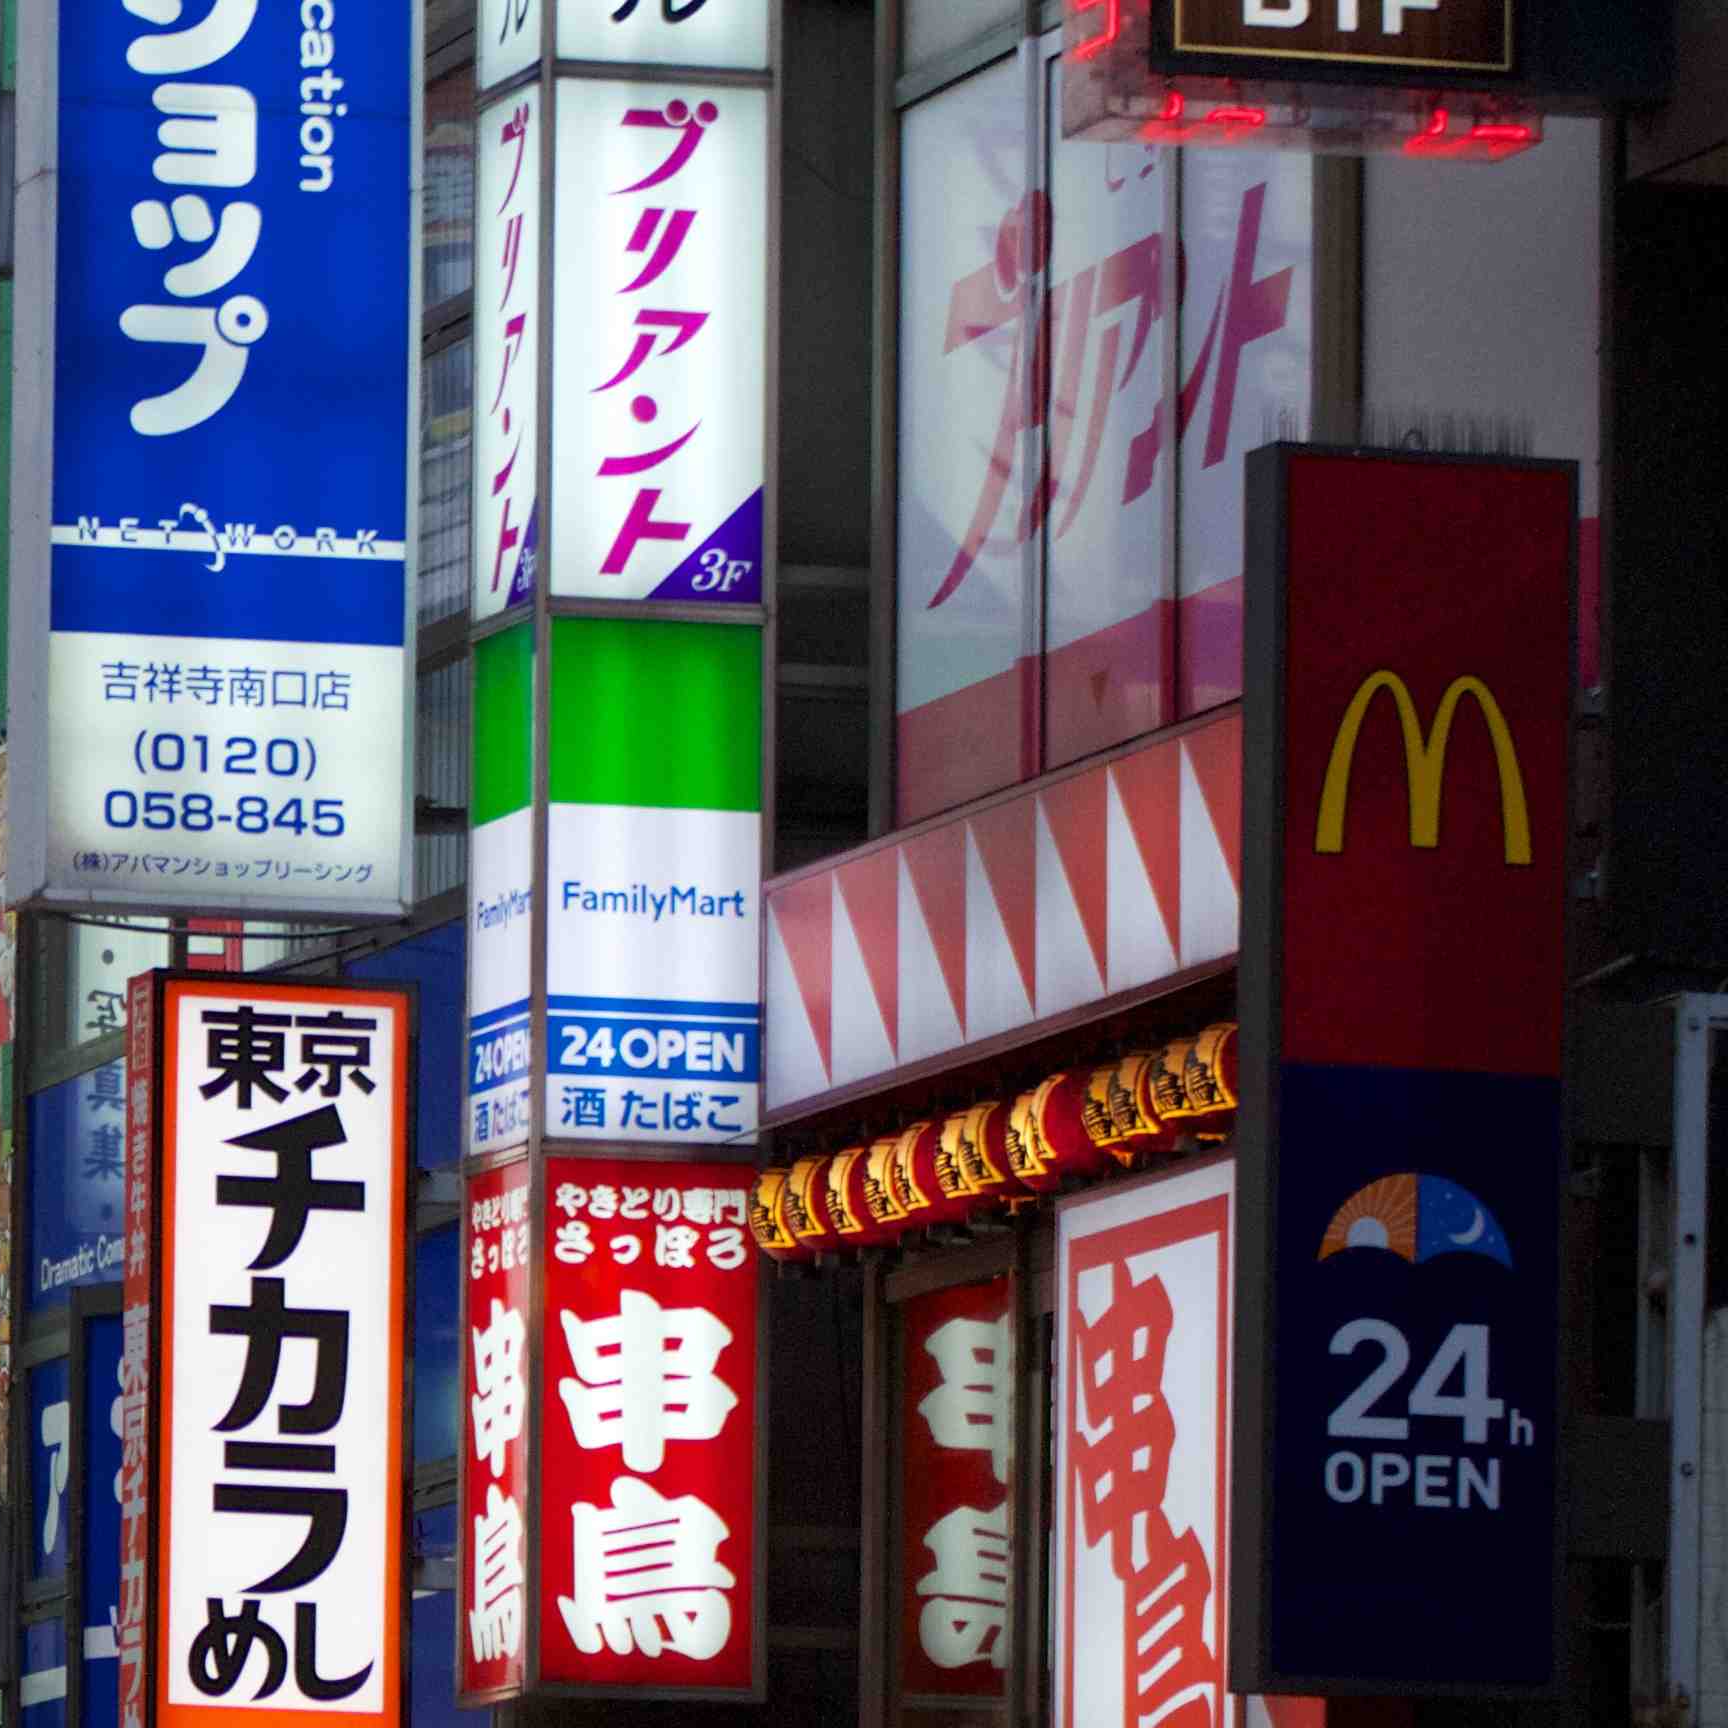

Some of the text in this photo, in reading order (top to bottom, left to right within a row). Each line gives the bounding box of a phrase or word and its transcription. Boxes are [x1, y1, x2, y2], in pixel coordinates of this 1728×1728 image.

[691, 548, 752, 592] 3F
[101, 661, 352, 711] 吉祥寺南口店
[132, 729, 319, 781] (0120)
[103, 789, 346, 839] 058-845
[475, 886, 533, 931] FamilyMart
[561, 880, 745, 923] FamilyMart
[198, 1005, 379, 1111] 東京
[561, 1086, 743, 1133] 酒 たばこ
[556, 1182, 747, 1224] やきとり専門
[554, 1220, 747, 1270] さっぽろ
[469, 1296, 526, 1663] 串鳥
[556, 1287, 740, 1662] 串鳥
[1324, 1450, 1502, 1511] OPEN
